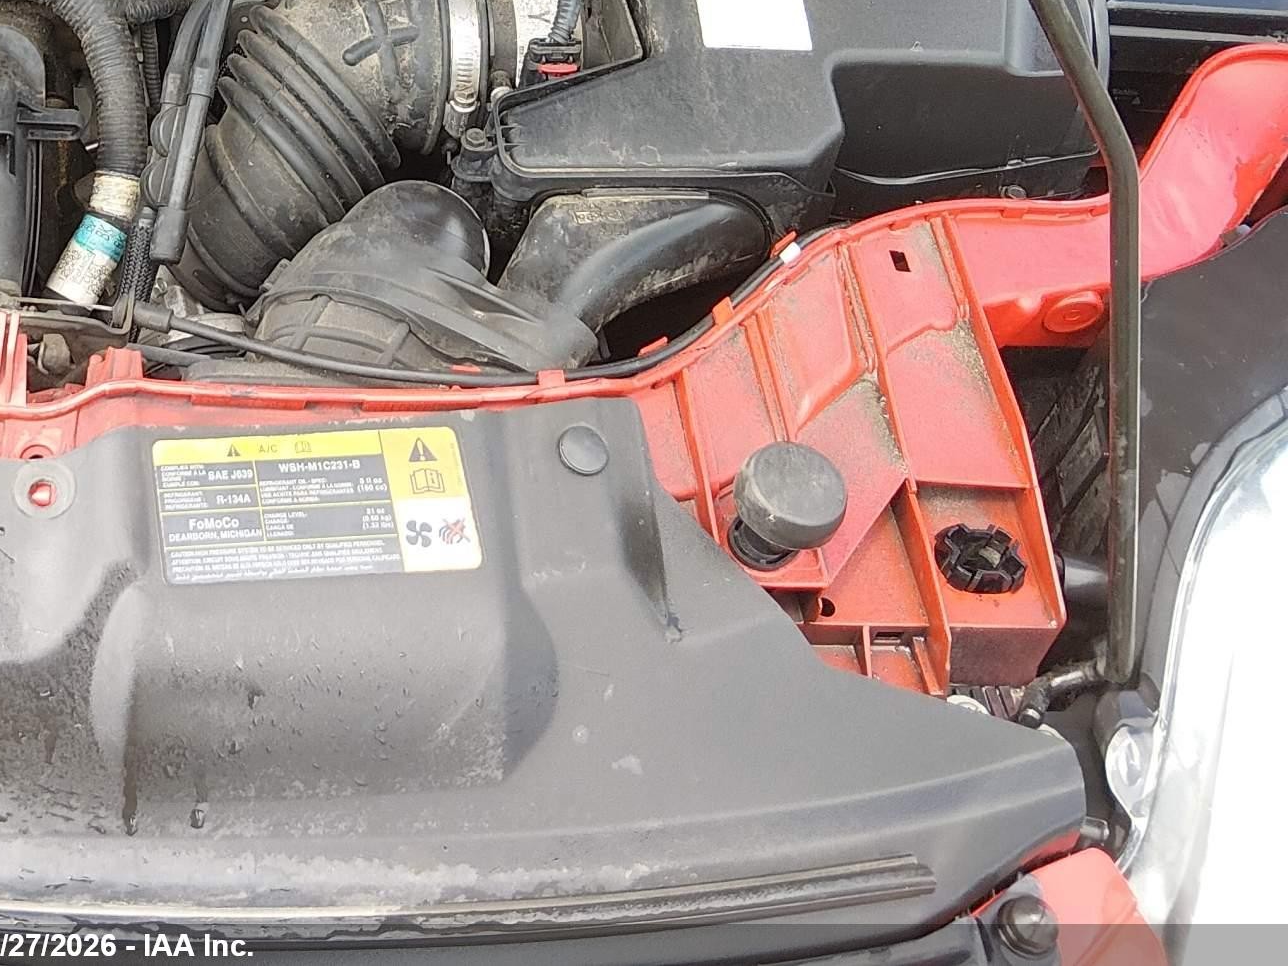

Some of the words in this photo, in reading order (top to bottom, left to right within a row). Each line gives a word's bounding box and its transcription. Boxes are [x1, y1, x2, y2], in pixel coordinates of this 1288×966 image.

[258, 443, 278, 454] A/C
[277, 459, 359, 473] WSH-M1C231-B
[208, 469, 228, 480] SAE
[230, 468, 253, 479] J639
[216, 493, 251, 504] R-134A
[189, 515, 239, 530] FoMoCo
[169, 530, 219, 542] DEARBORN,
[220, 528, 262, 539] MICHIGAN
